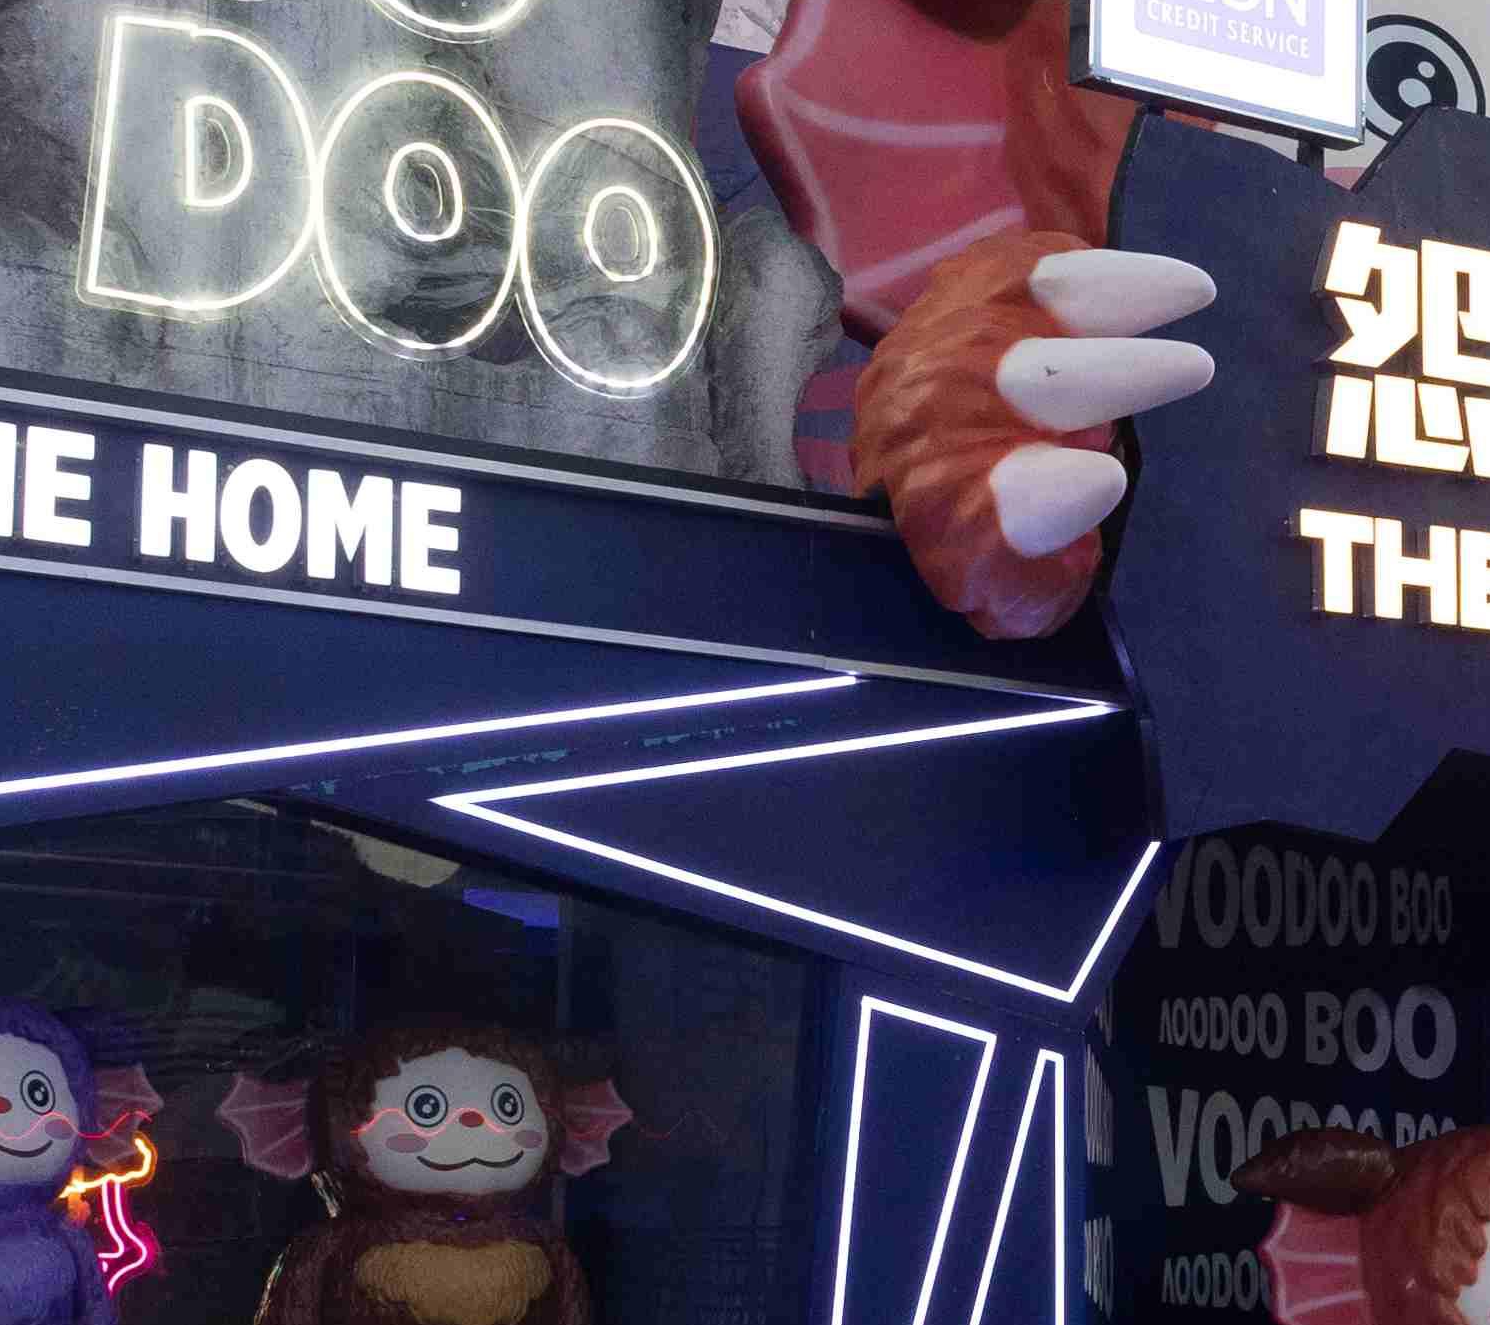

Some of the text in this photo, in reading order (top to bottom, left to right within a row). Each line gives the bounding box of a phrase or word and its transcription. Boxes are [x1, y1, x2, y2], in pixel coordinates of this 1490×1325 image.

[1227, 19, 1310, 59] SERVICE
[87, 14, 715, 388] DOO
[139, 443, 463, 596] HOME
[1389, 867, 1452, 946] BOO
[1305, 984, 1457, 1080] BOO
